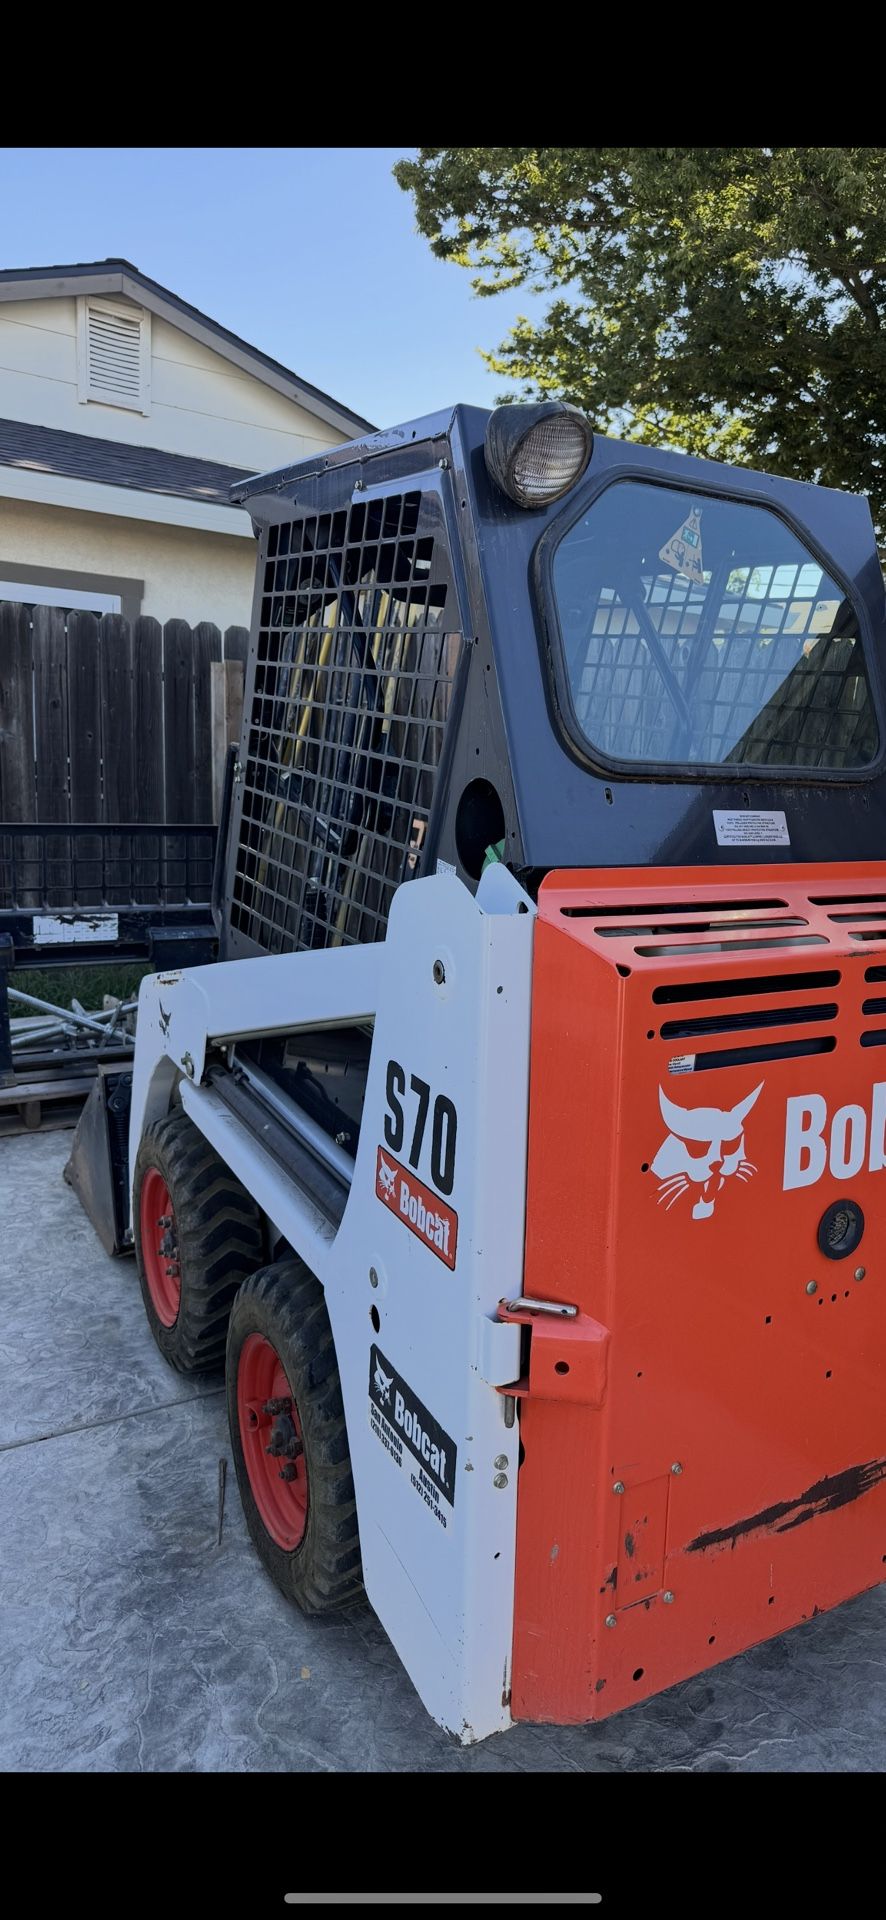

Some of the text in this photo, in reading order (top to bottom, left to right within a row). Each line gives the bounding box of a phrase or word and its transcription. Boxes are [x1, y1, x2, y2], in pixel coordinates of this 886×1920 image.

[384, 1060, 458, 1196] S70
[371, 1402, 403, 1455] San Antonio
[411, 1473, 424, 1497] (512)
[419, 1468, 440, 1504] Austin
